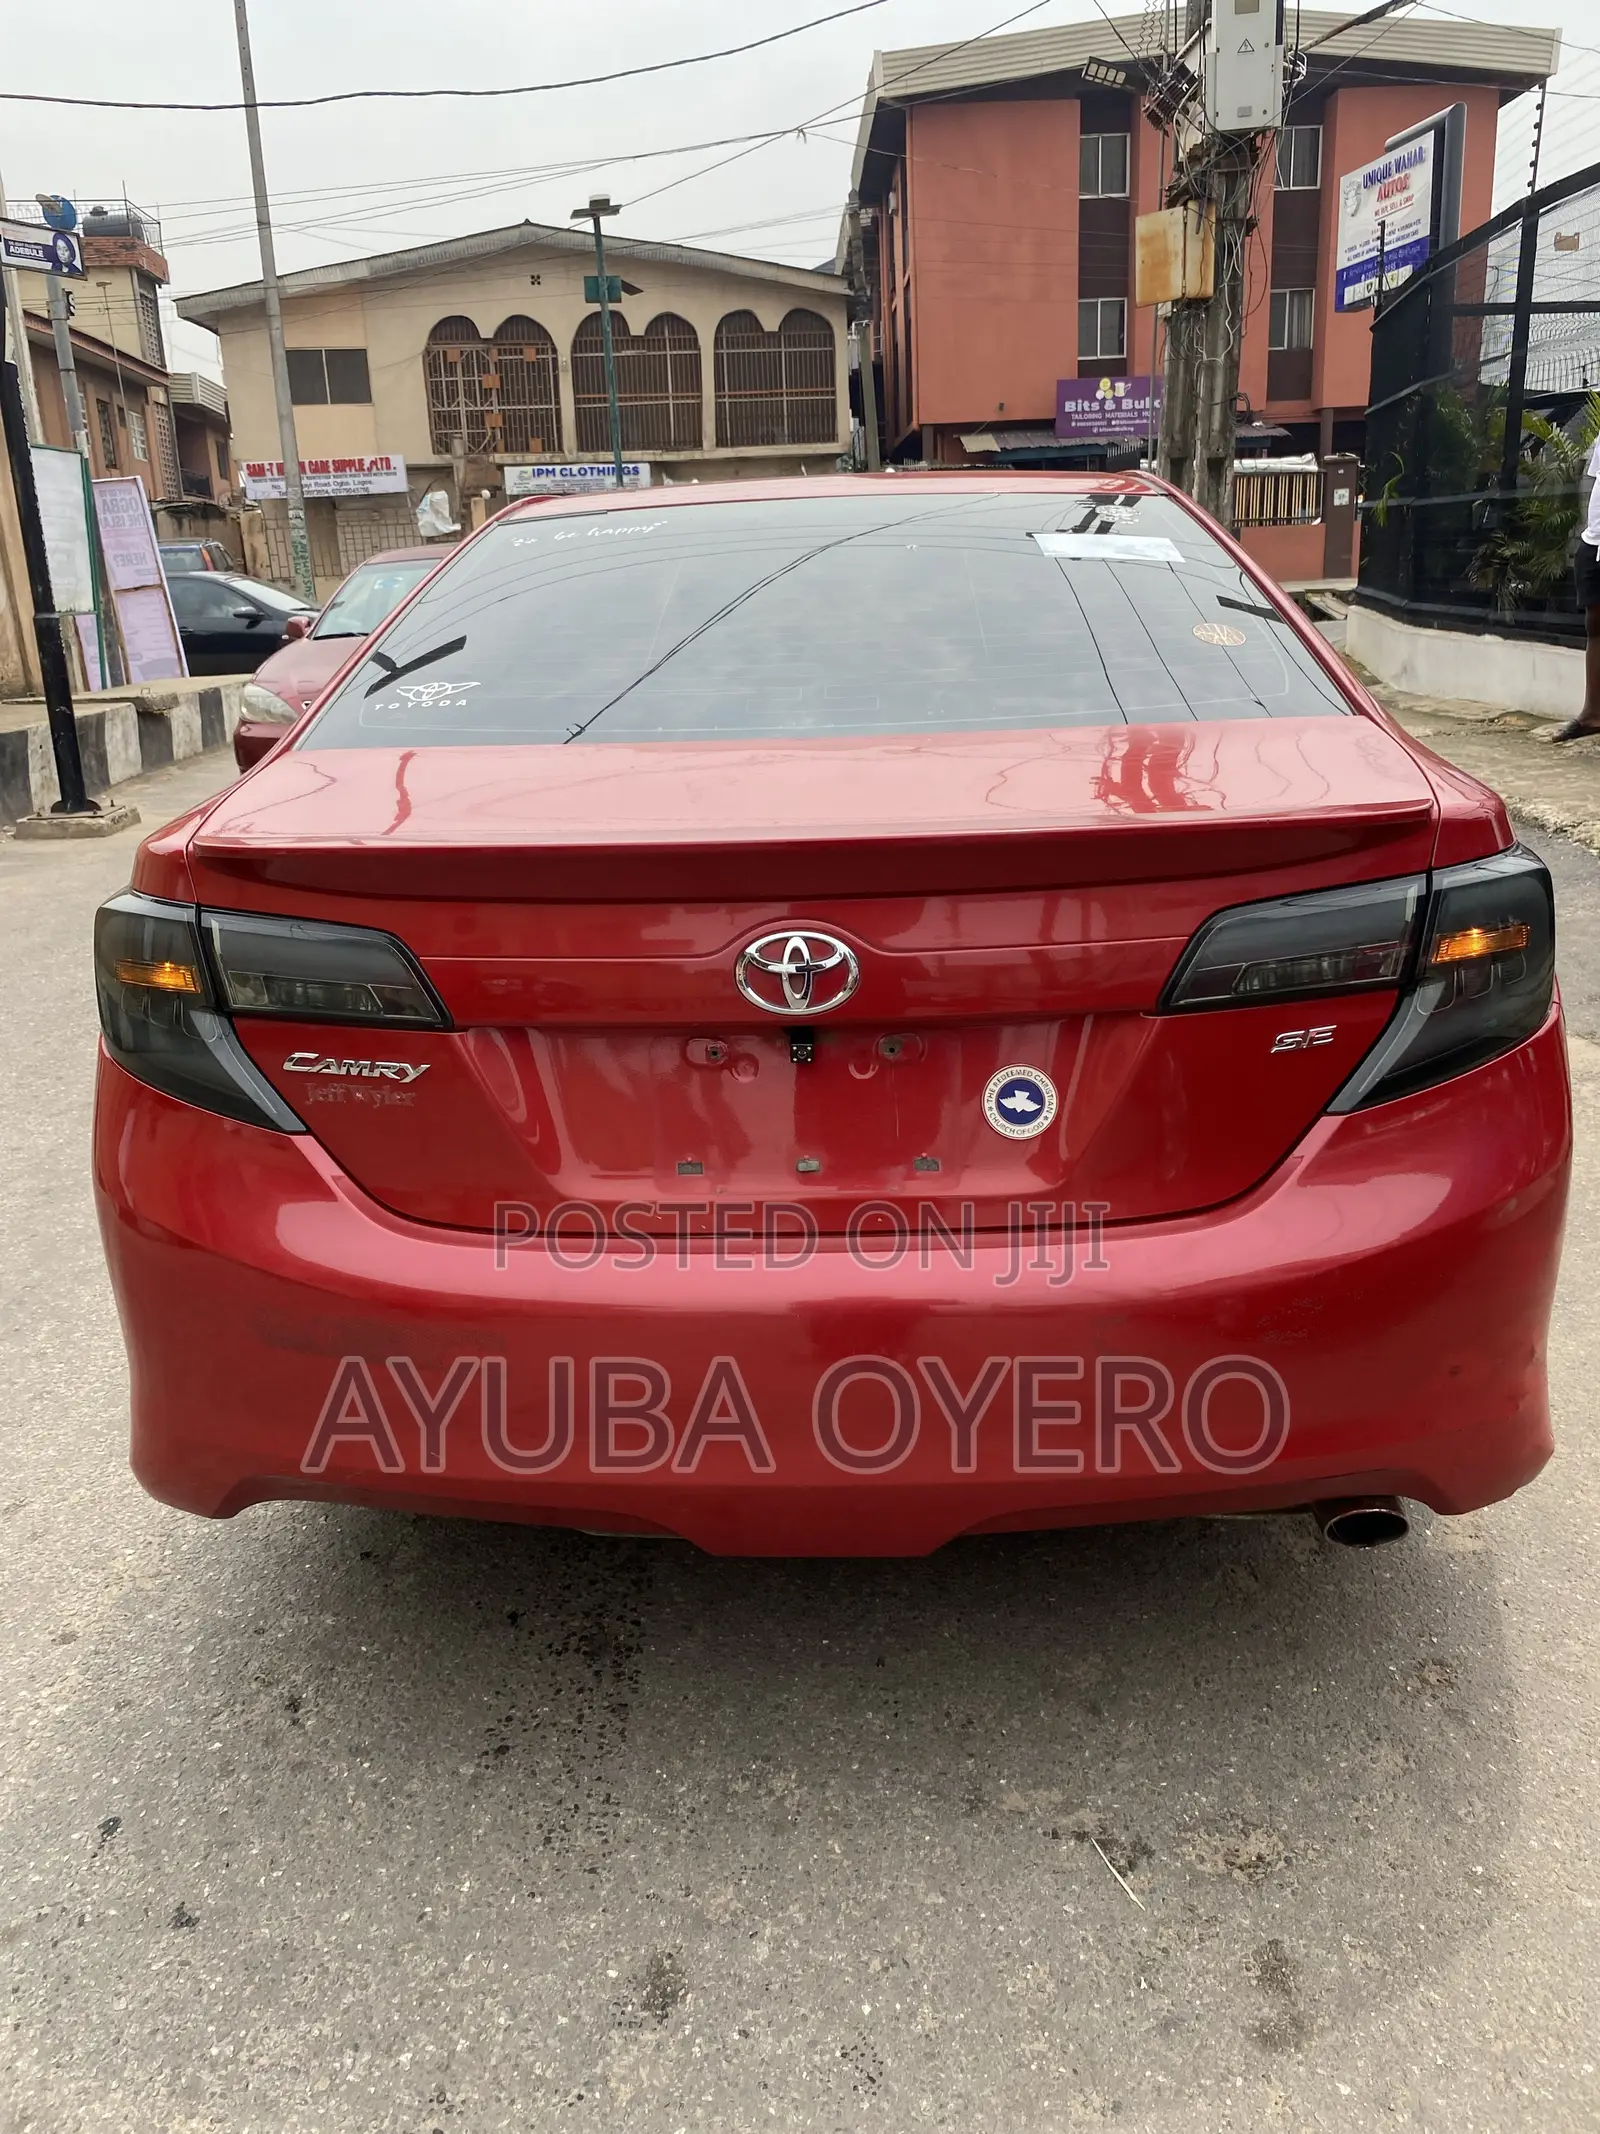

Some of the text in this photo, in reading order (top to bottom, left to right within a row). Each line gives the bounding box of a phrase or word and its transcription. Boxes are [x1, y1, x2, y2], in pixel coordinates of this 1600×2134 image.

[1363, 160, 1392, 189] UNIQUE
[1377, 174, 1409, 203] AUTOS
[9, 245, 44, 258] ADEBULE
[1065, 400, 1100, 412] Bits
[1104, 399, 1116, 411] &
[1071, 412, 1102, 420] TAILORING
[308, 459, 332, 474] CARE
[532, 467, 556, 478] IPM
[1270, 1024, 1337, 1053] SE
[283, 1052, 431, 1083] CAMRY
[986, 1069, 1055, 1114] THE REDEEMED CHRISTIAN
[989, 1112, 1044, 1136] CHURCH OF GOD
